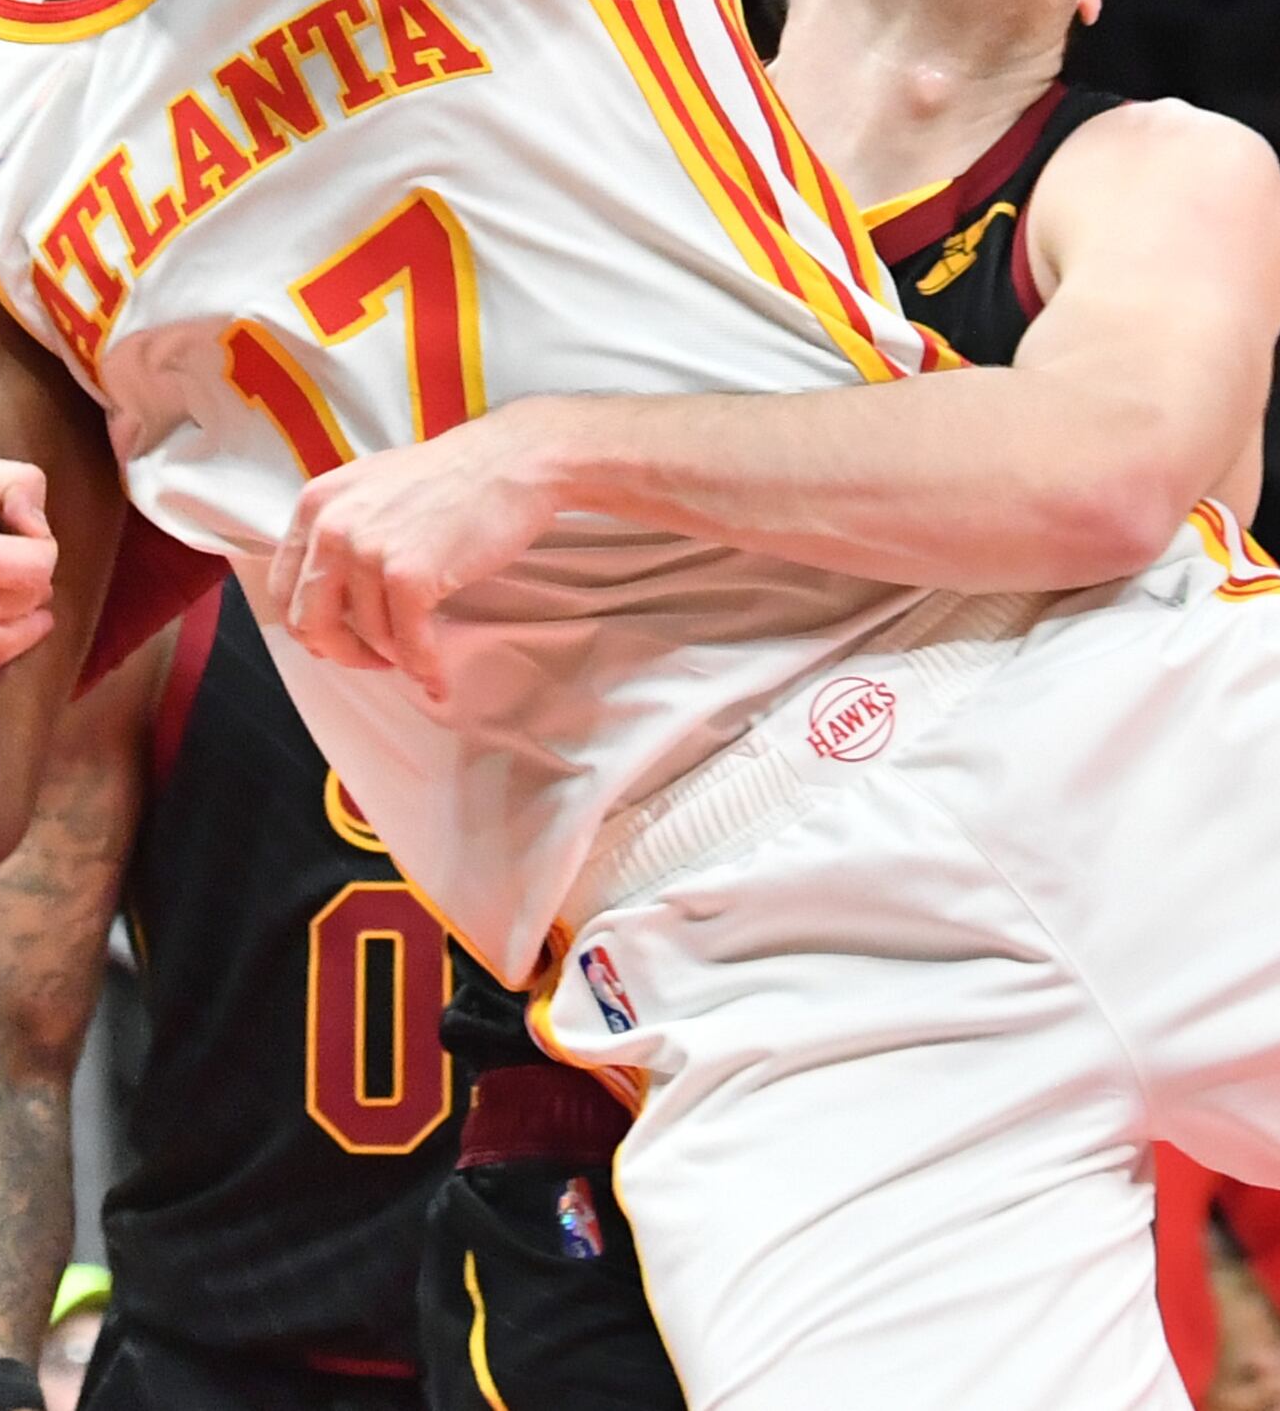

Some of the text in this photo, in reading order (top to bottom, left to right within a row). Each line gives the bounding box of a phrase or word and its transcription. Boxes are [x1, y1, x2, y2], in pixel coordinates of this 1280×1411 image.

[218, 186, 487, 480] 17
[806, 682, 896, 758] HAWKS
[306, 880, 452, 1154] 0
